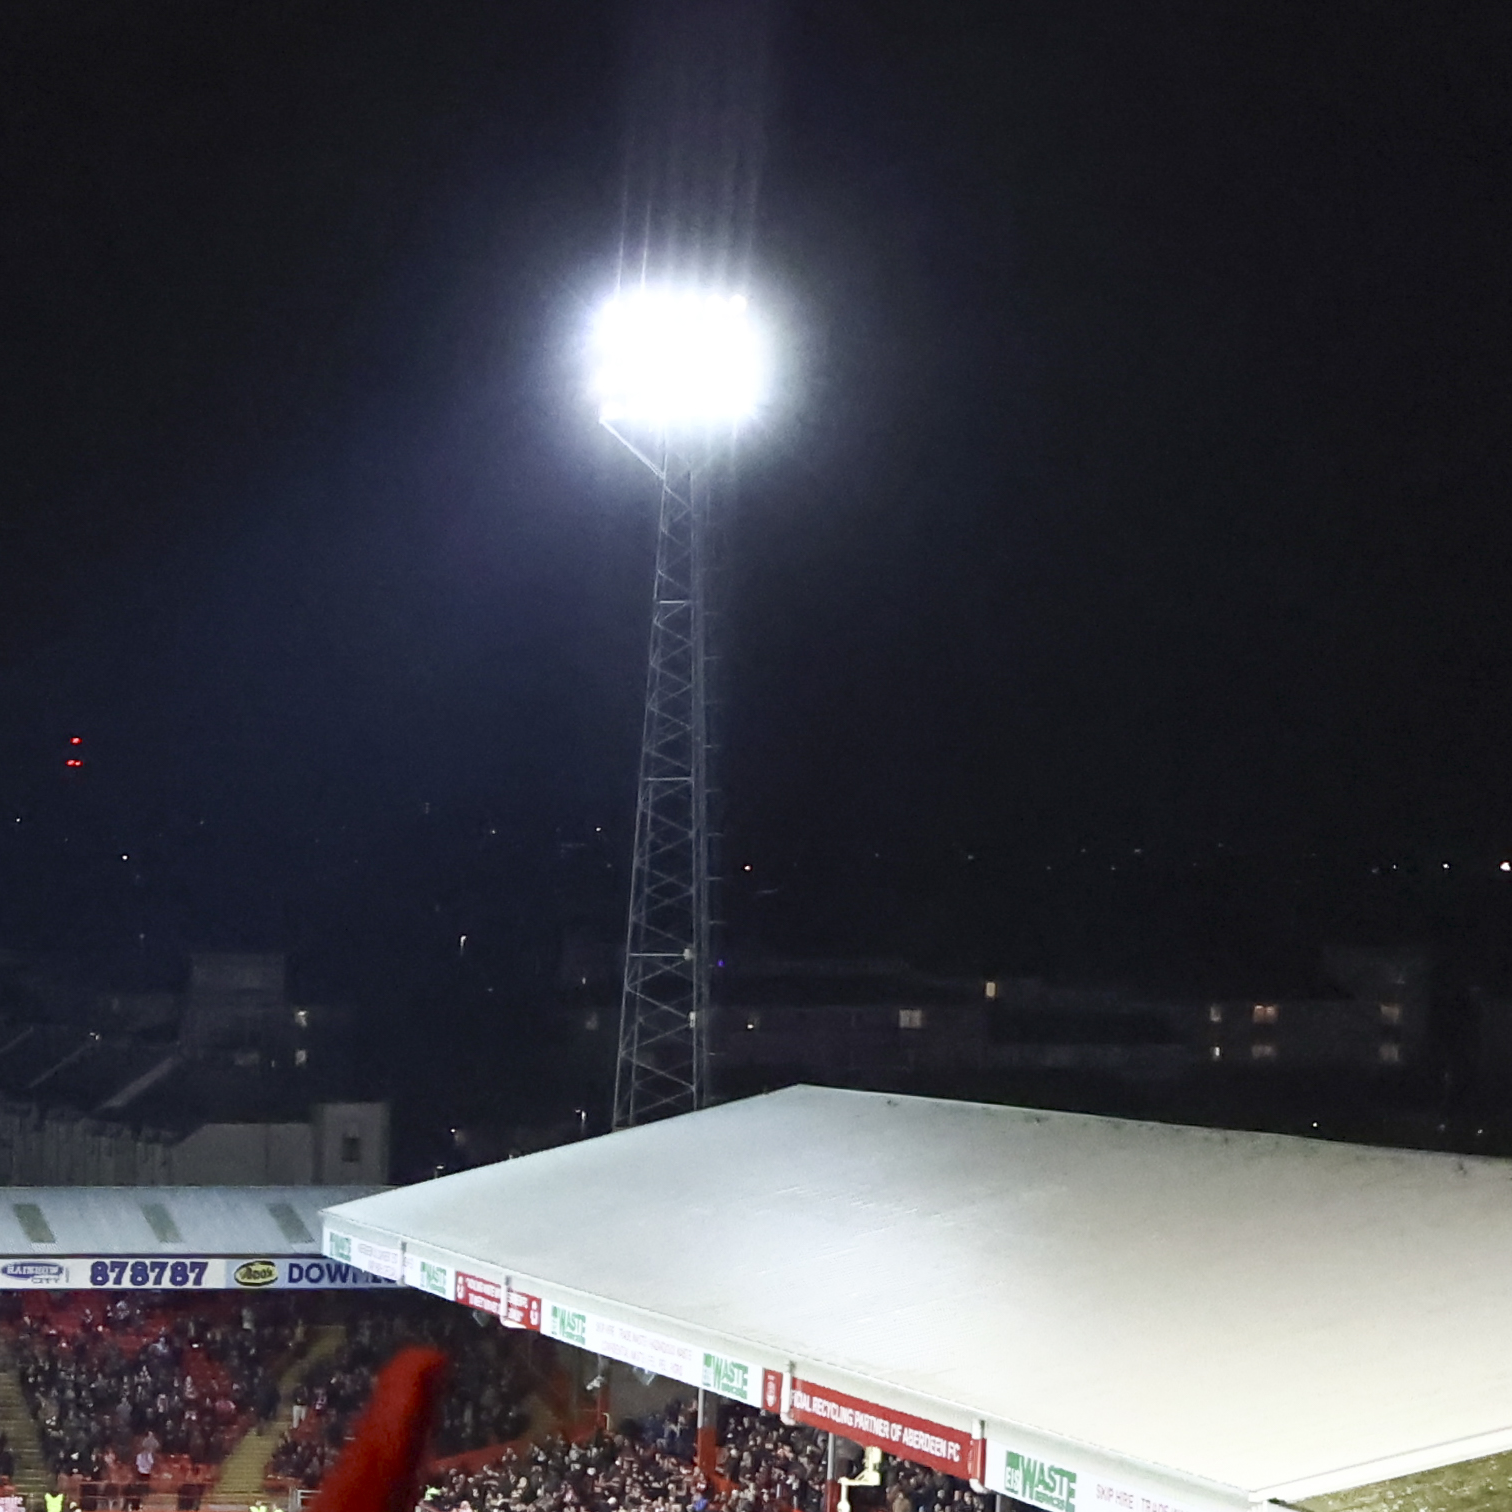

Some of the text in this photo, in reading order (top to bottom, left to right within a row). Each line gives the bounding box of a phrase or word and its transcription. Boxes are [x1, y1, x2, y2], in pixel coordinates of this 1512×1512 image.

[89, 1261, 208, 1287] 878787
[813, 1397, 855, 1425] RECYCLING
[855, 1410, 890, 1439] PARTNER
[891, 1422, 903, 1442] OF
[903, 1427, 947, 1458] ABERDEEN
[947, 1442, 961, 1463] FC
[1019, 1454, 1077, 1512] WASTE
[1095, 1484, 1114, 1501] SKIP
[1115, 1490, 1135, 1510] HIRE
